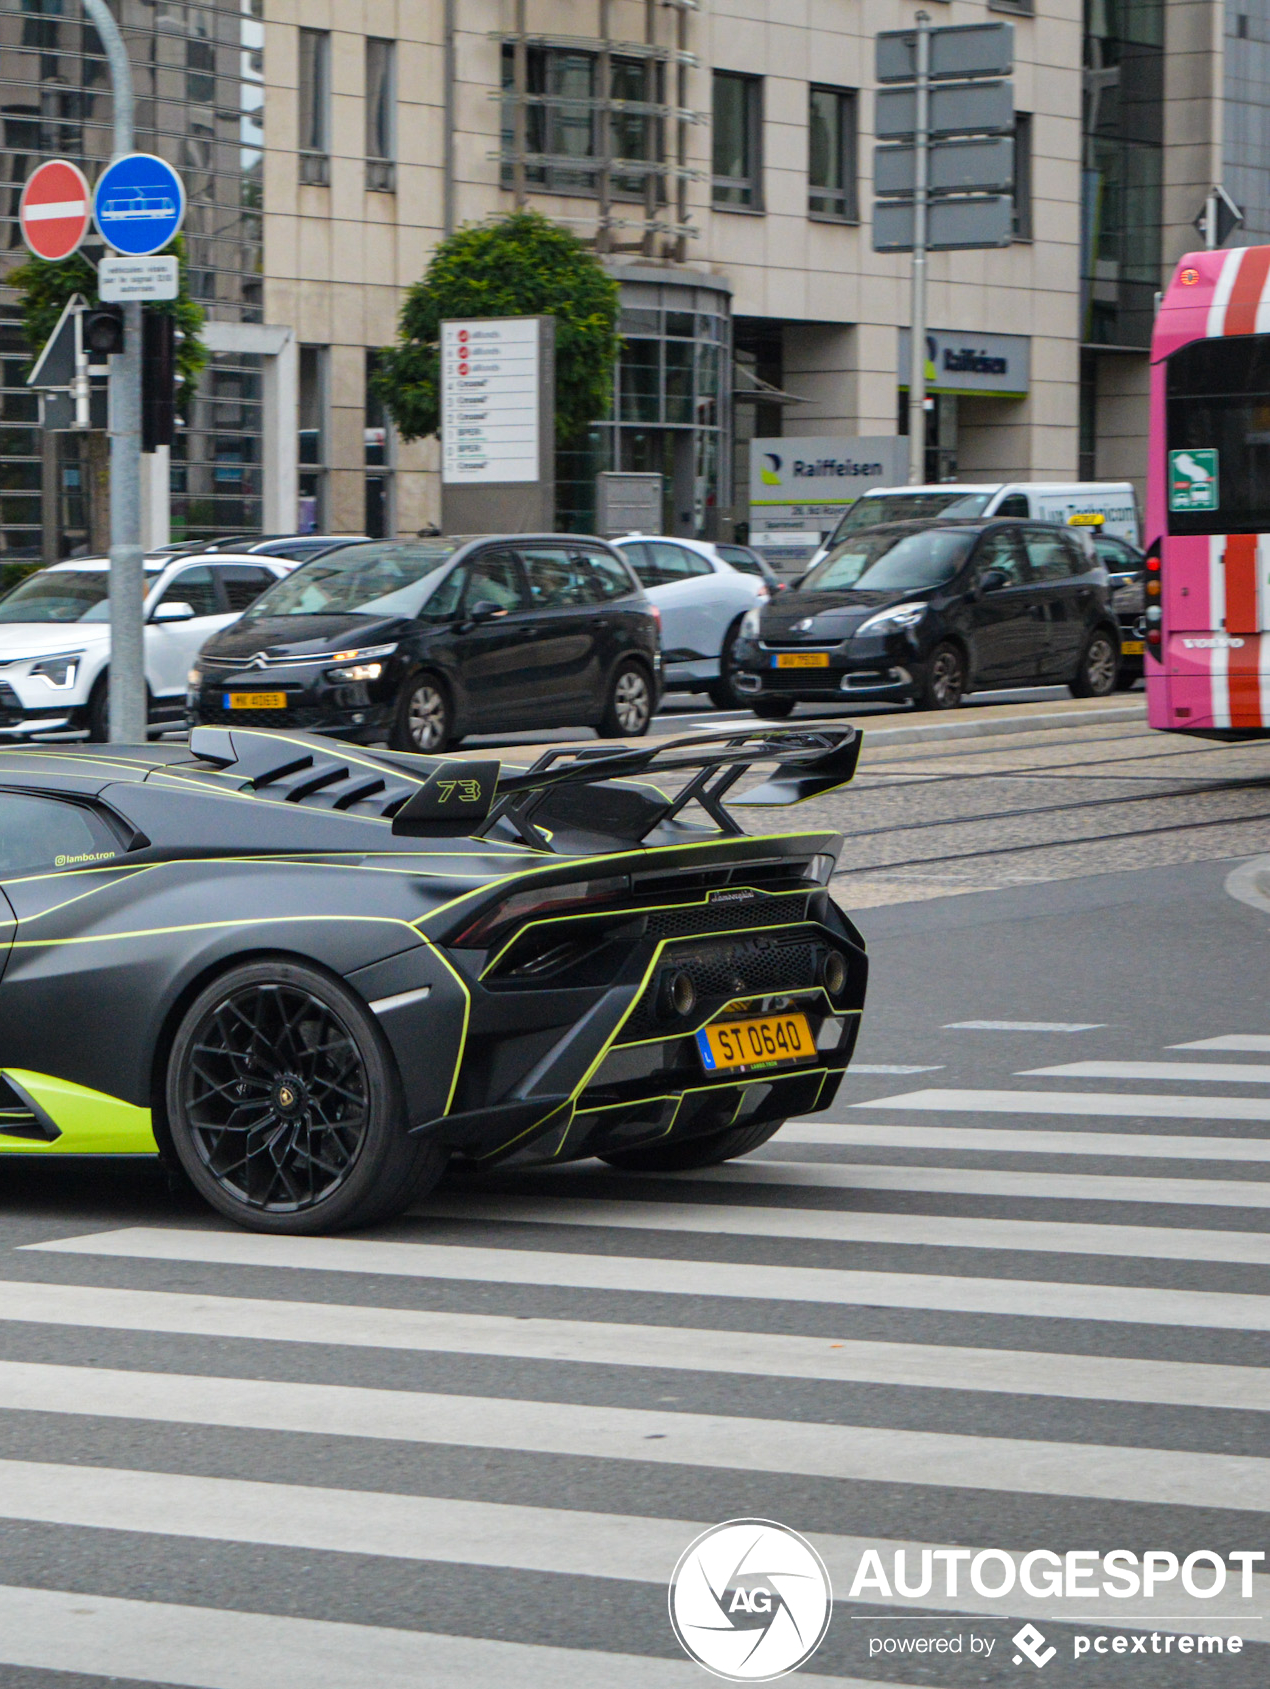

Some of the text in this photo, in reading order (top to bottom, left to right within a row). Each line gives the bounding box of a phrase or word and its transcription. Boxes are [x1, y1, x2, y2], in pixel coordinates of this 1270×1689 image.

[943, 348, 1007, 374] Raiffeisen
[793, 459, 882, 477] Raiffeisen
[1182, 638, 1245, 649] VOLVO
[436, 780, 482, 803] 73
[718, 1021, 801, 1060] ST 0640
[704, 1052, 711, 1063] L
